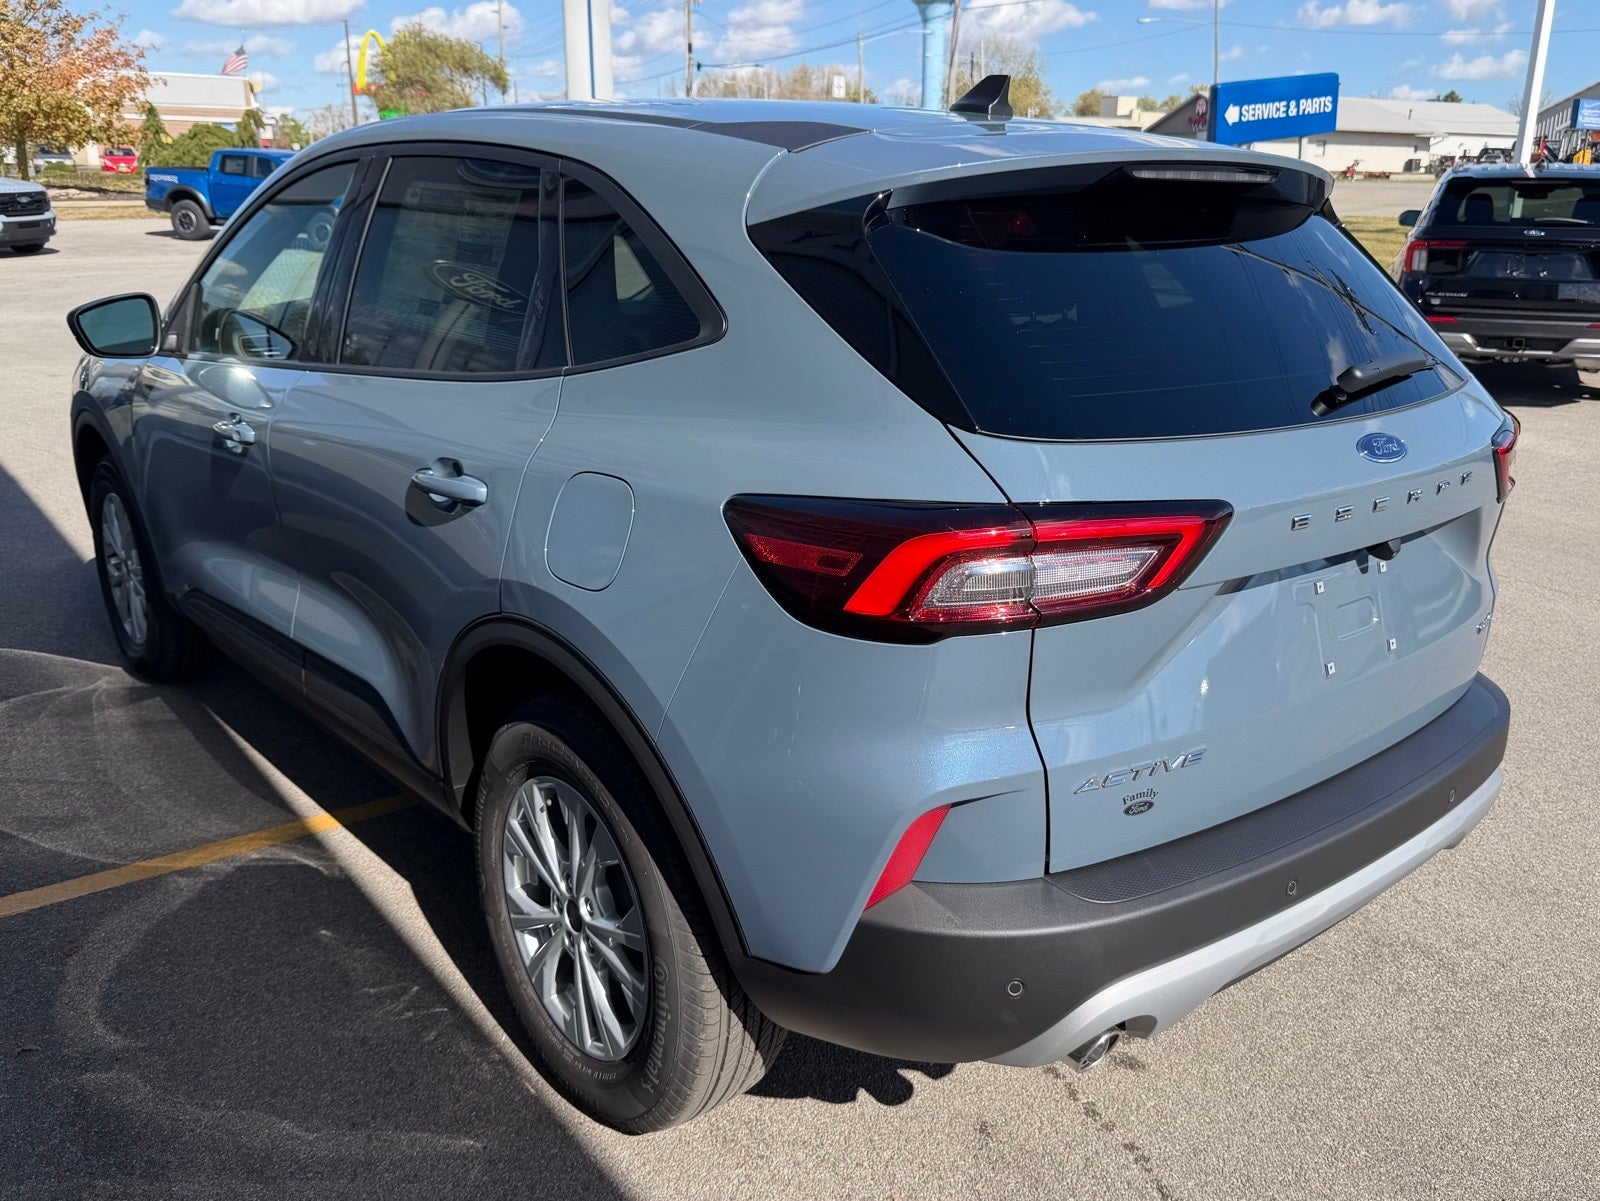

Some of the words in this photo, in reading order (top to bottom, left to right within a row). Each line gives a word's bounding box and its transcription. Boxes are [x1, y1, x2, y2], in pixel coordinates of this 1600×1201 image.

[1241, 100, 1288, 122] SERVICE
[1288, 100, 1298, 117] &
[1299, 96, 1333, 116] PARTS
[449, 272, 524, 309] Ford
[1371, 436, 1401, 456] Ford
[1073, 744, 1208, 795] ACTIVE
[1121, 787, 1159, 806] Family
